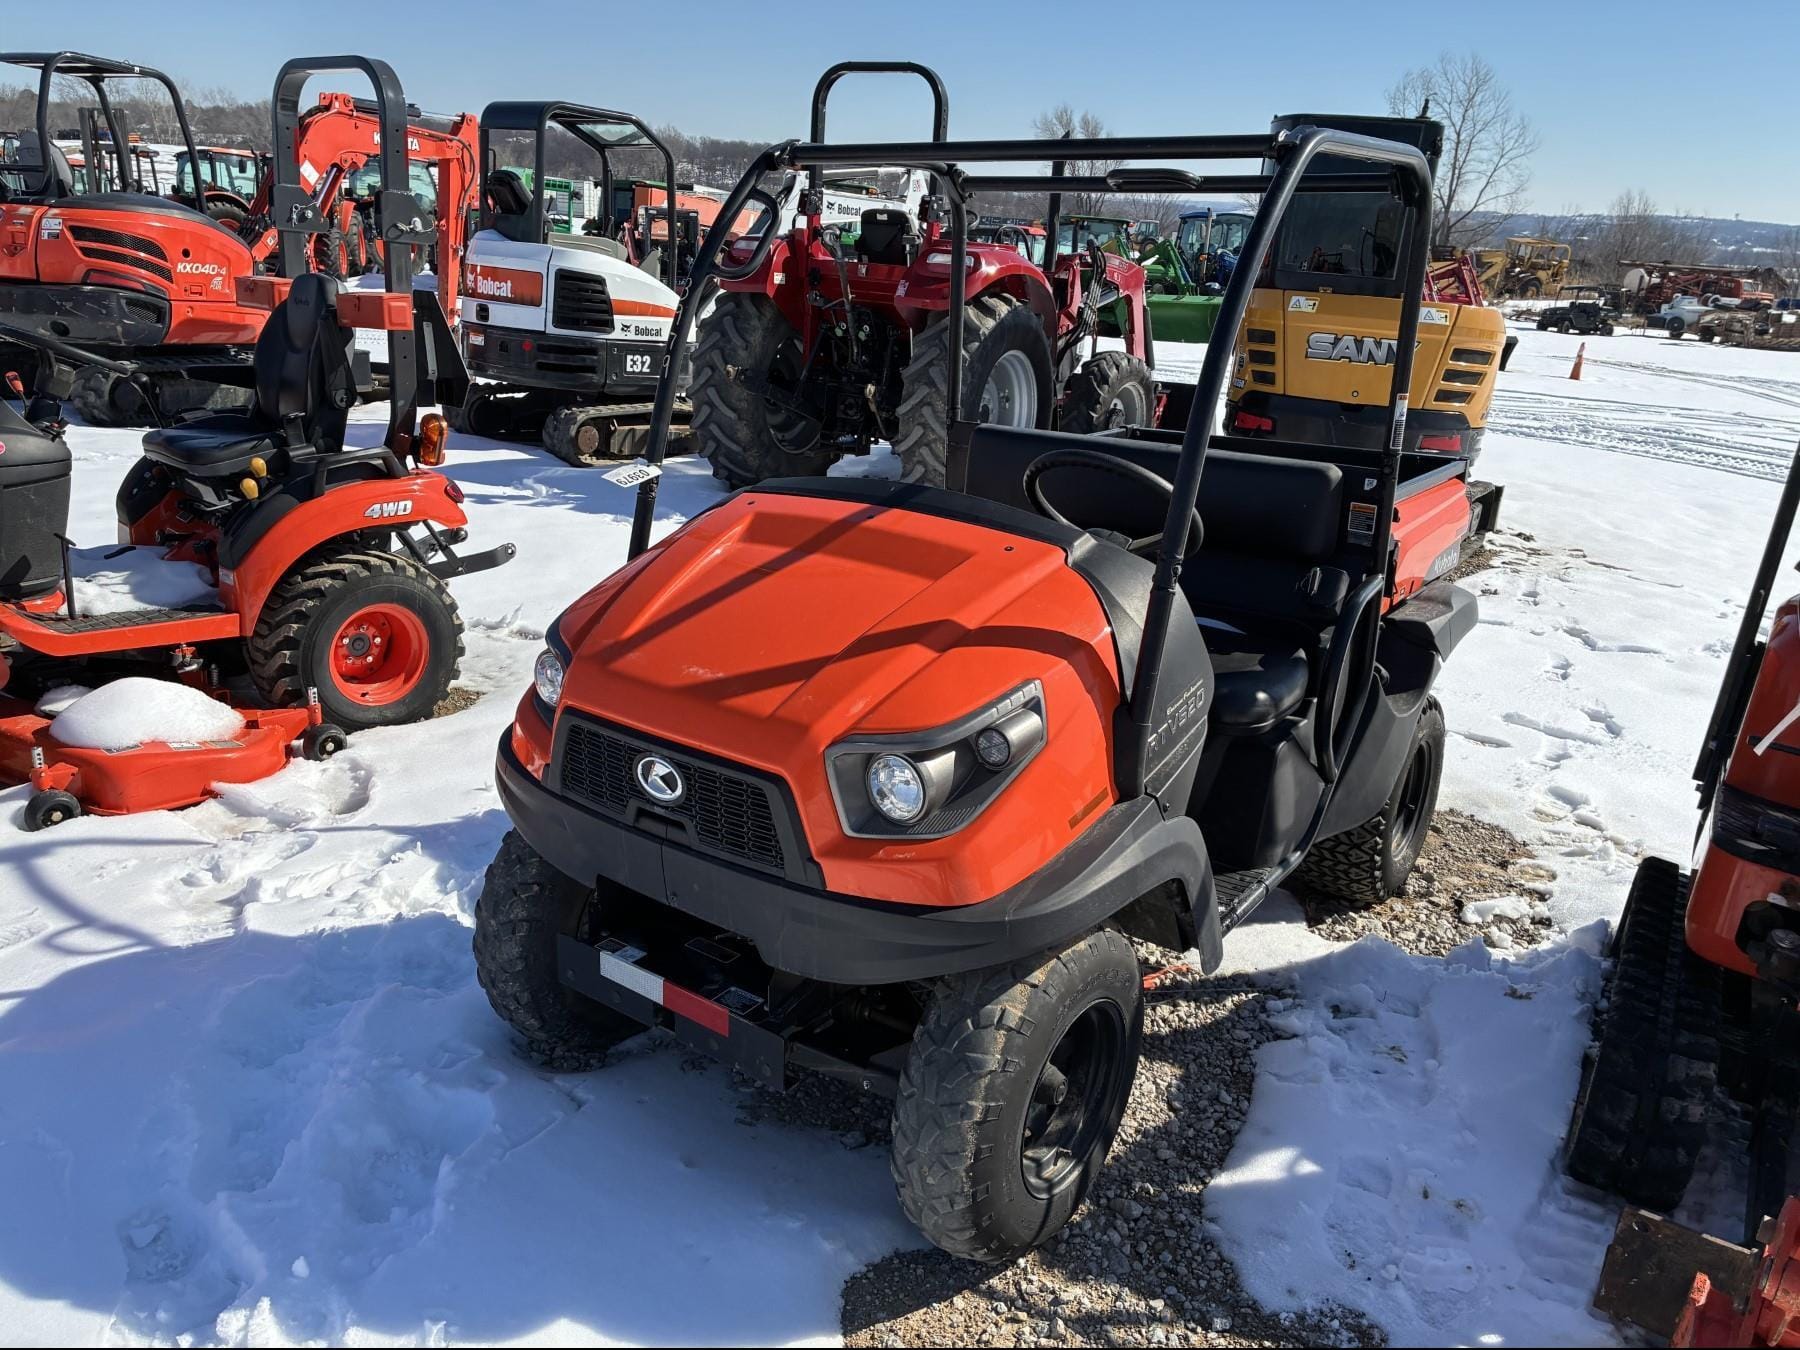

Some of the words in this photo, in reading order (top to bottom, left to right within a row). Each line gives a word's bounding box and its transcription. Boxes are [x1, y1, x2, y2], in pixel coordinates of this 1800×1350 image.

[837, 203, 861, 217] Bobcat
[177, 262, 227, 275] KX040-4
[476, 276, 512, 298] Bobcat
[634, 325, 662, 337] Bobcat
[626, 354, 651, 372] E32
[615, 469, 650, 486] 03979
[363, 500, 413, 519] 4WD
